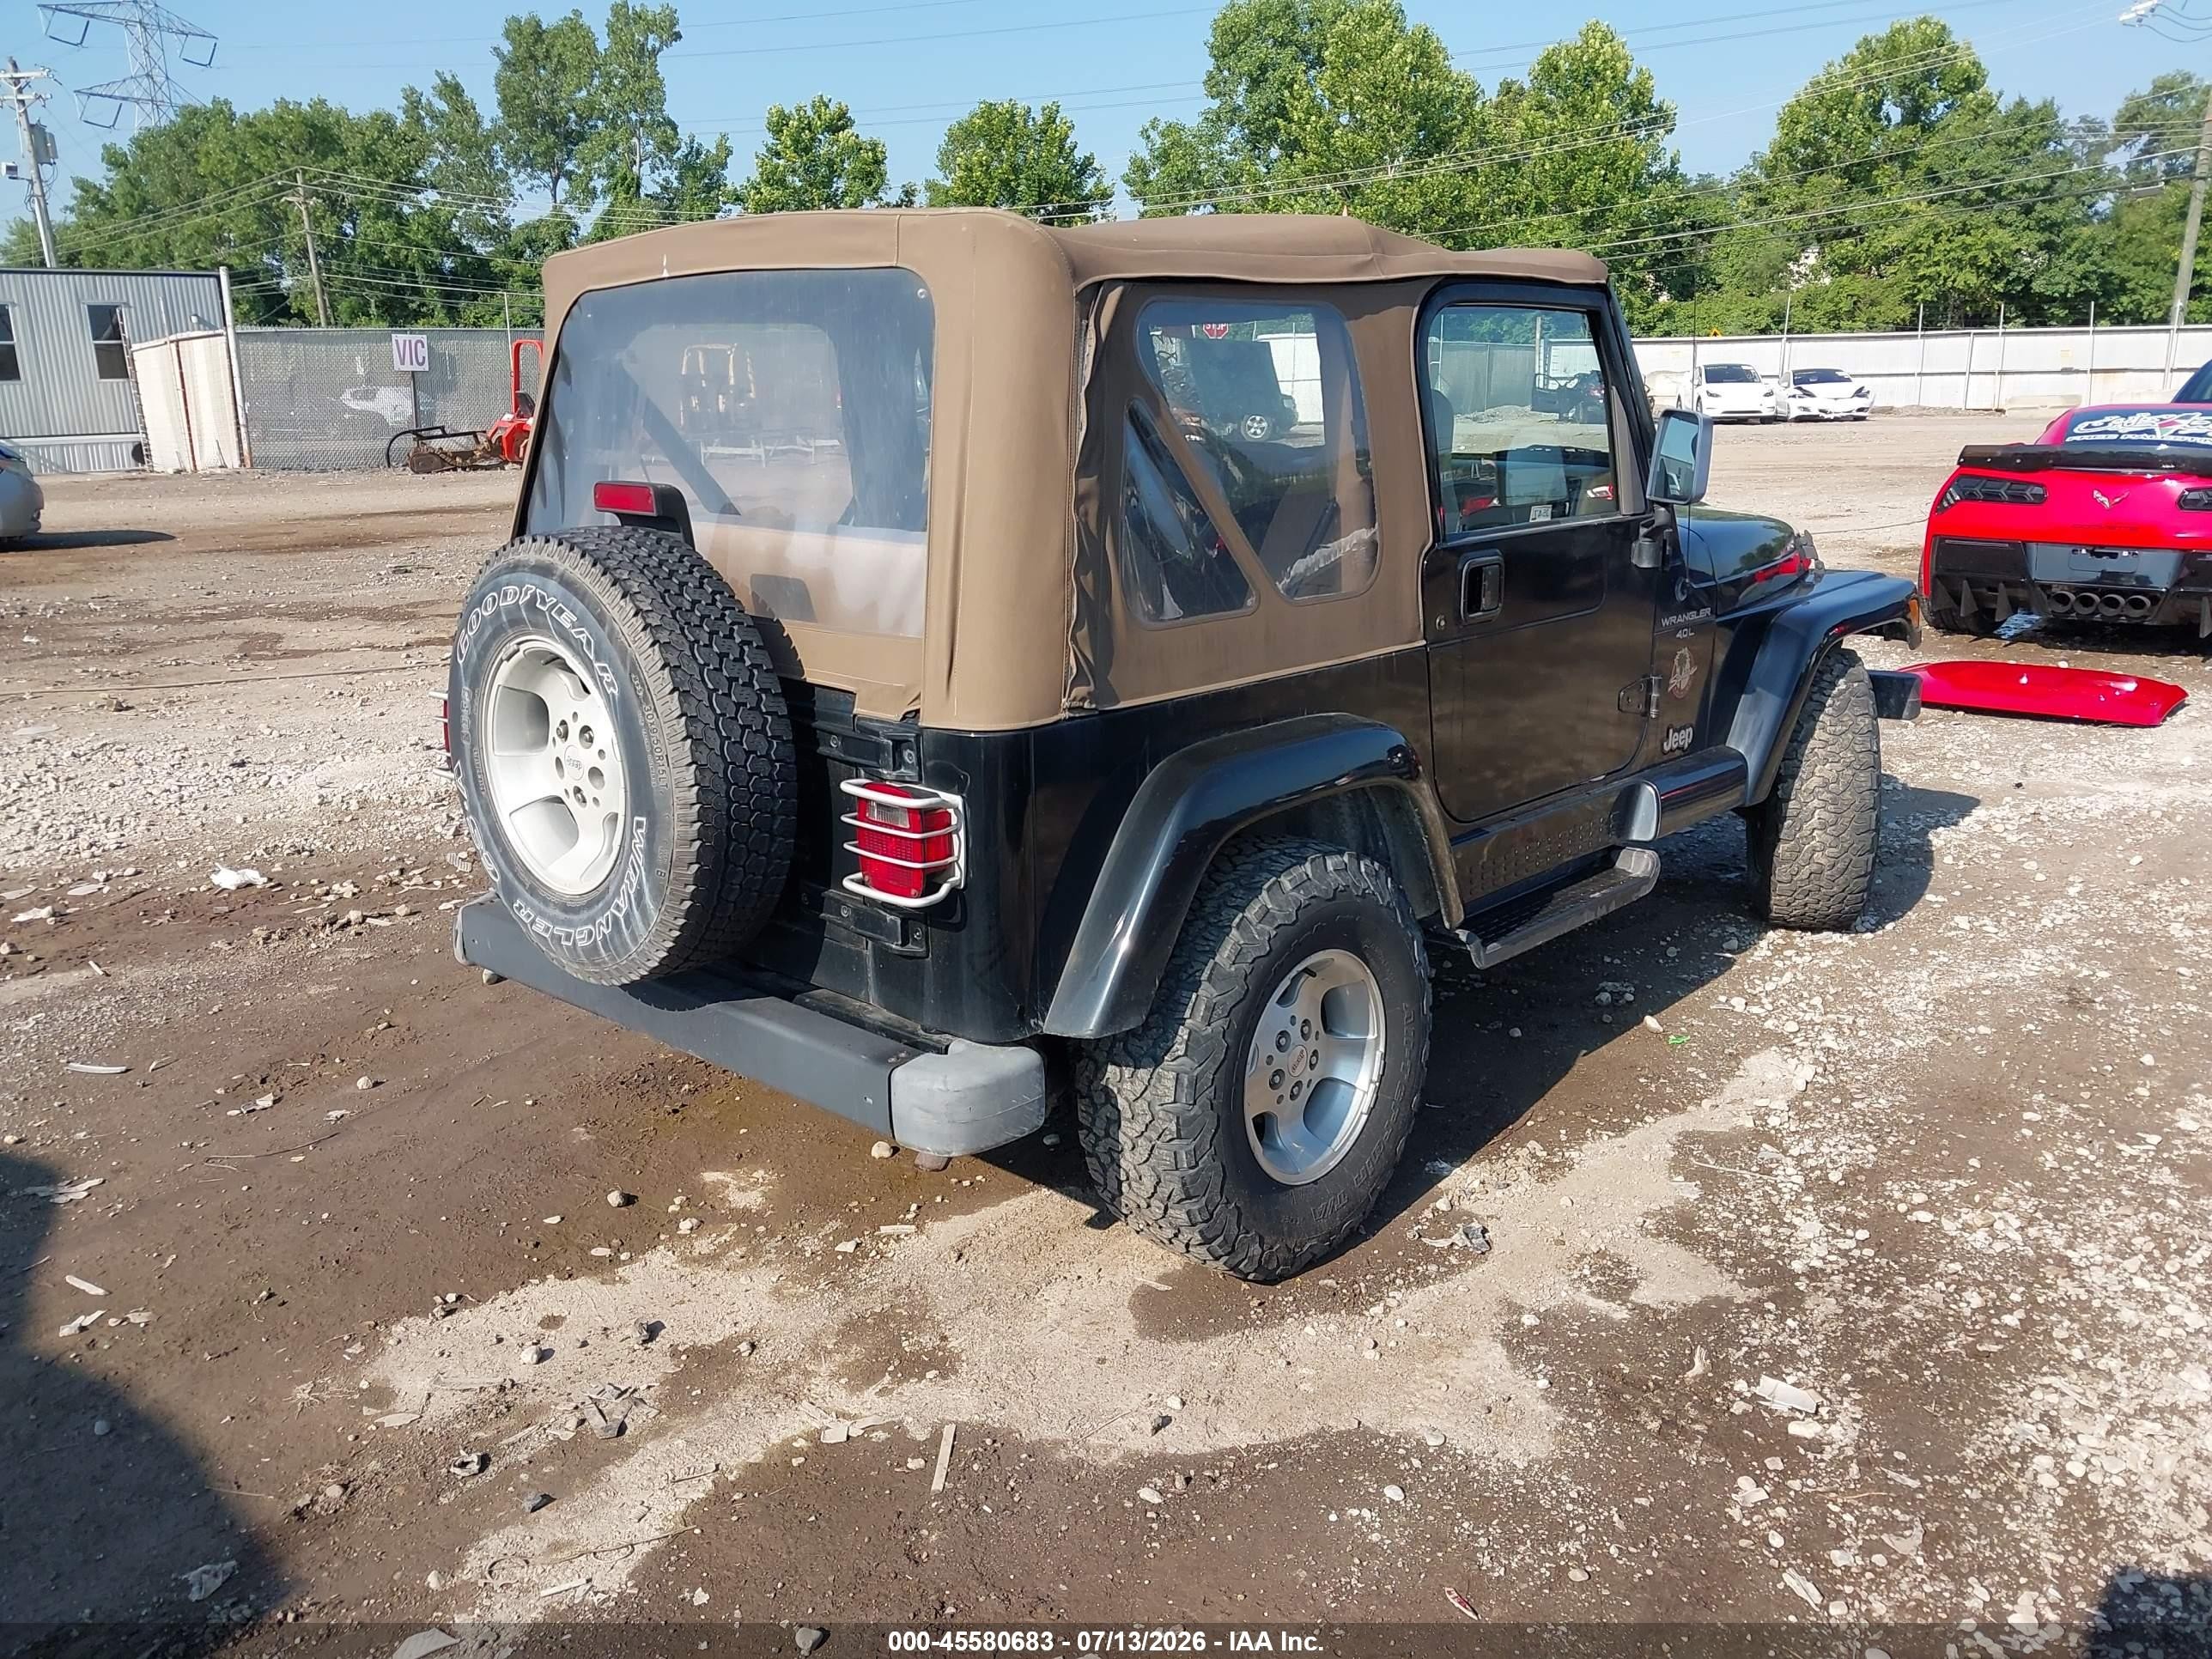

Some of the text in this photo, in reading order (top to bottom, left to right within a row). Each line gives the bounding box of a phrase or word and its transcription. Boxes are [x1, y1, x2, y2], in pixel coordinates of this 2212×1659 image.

[395, 339, 426, 367] VIC
[1662, 607, 1711, 628] WRANGLER
[457, 585, 618, 695] GOODYEAR
[1663, 726, 1693, 752] Jeep
[514, 817, 647, 947] WRANGLER
